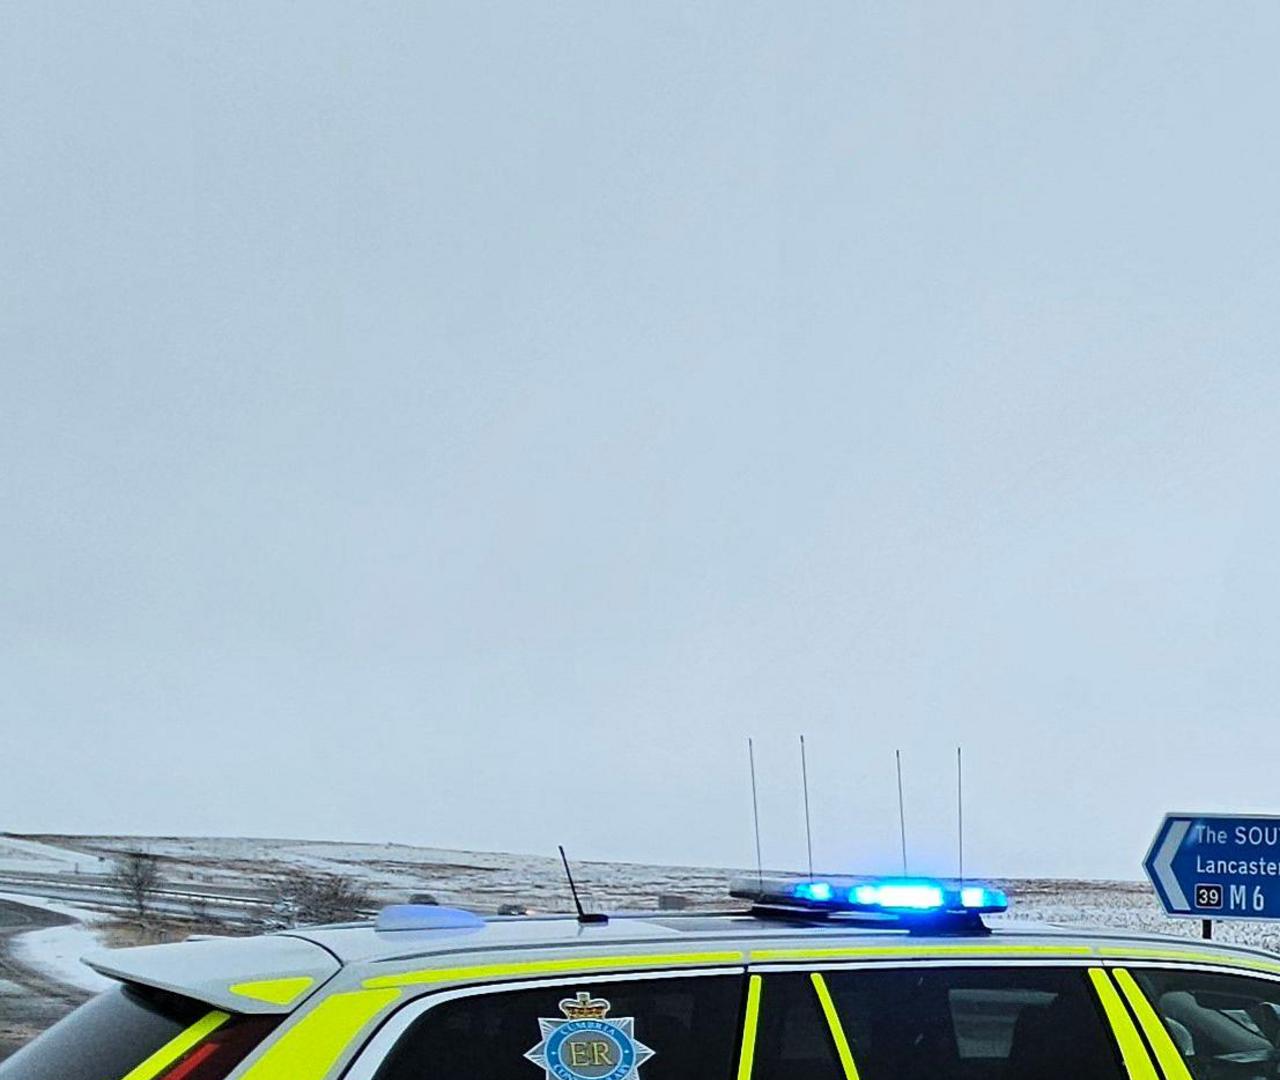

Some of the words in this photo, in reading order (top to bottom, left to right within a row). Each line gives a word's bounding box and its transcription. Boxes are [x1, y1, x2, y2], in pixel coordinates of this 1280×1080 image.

[1195, 825, 1228, 844] The
[1198, 888, 1220, 905] 39
[560, 1021, 616, 1036] CUMBRIA
[569, 1041, 613, 1067] ER
